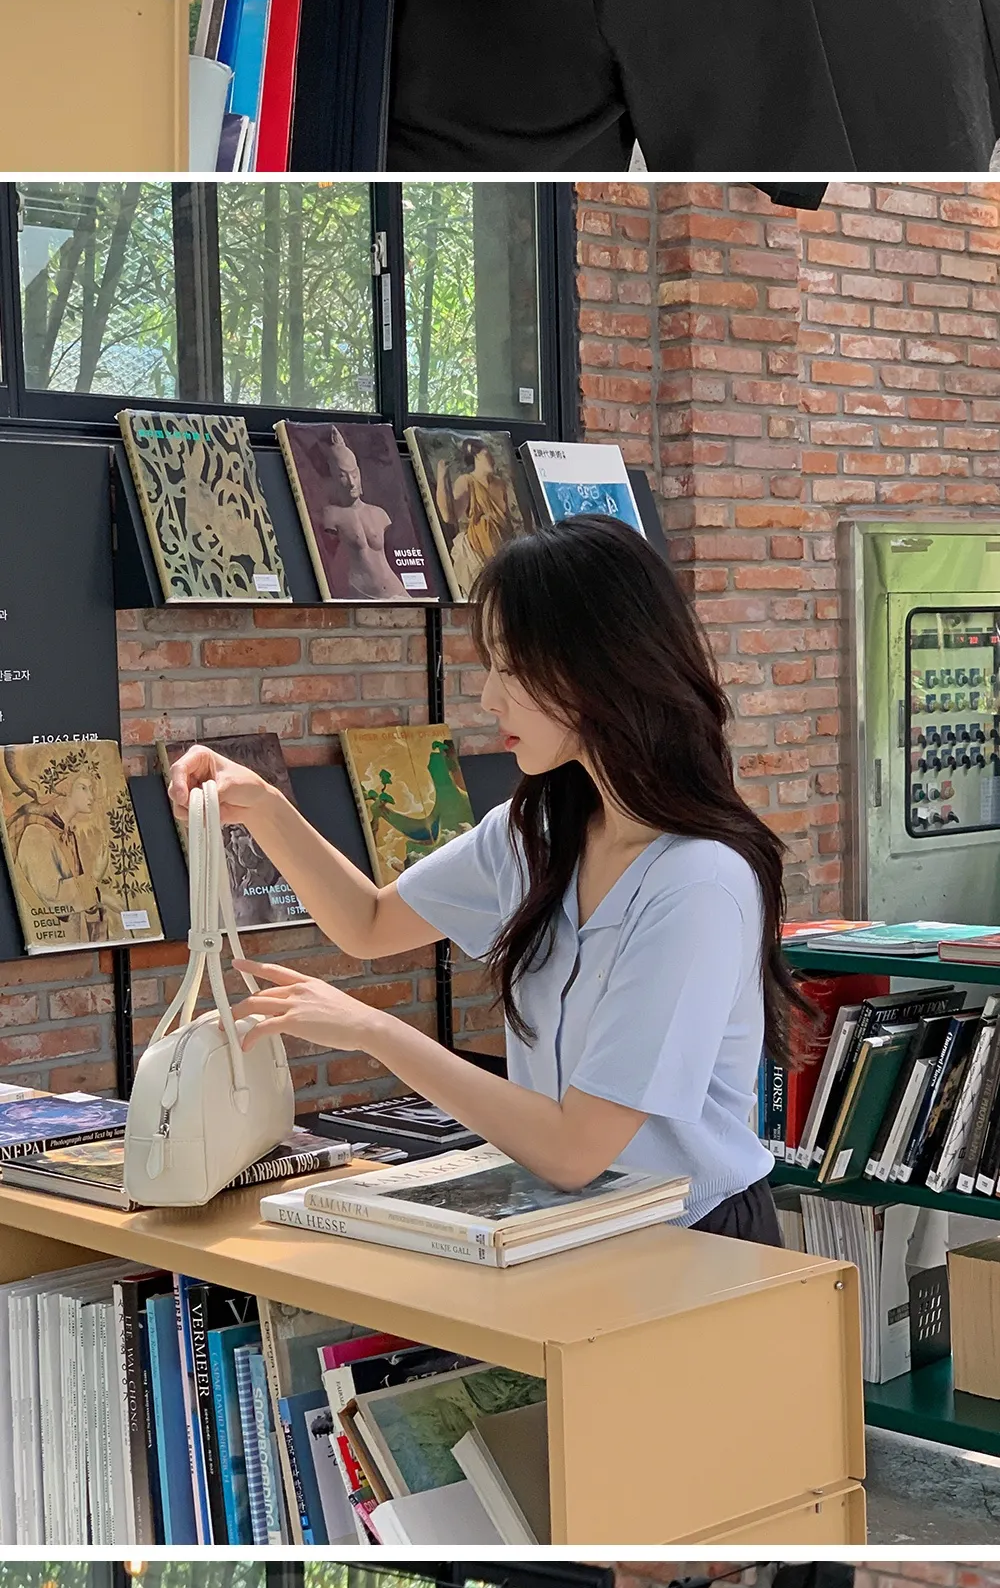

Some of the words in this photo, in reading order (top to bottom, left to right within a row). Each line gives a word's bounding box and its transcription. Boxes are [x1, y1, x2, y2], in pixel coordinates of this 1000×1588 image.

[394, 547, 423, 557] MUSÉE
[395, 558, 425, 566] GUIMET
[31, 905, 75, 916] GALLERIA
[33, 918, 60, 928] DEGLI
[36, 930, 66, 940] UFFIZI
[875, 1008, 900, 1023] THE
[773, 1066, 784, 1112] HORSE
[331, 1094, 417, 1116] CASABELLA
[50, 1135, 82, 1147] Photograph
[82, 1133, 94, 1141] and
[94, 1131, 105, 1140] Text
[106, 1129, 113, 1138] by
[296, 1152, 320, 1173] 1995
[309, 1194, 370, 1218] KAMAKURA
[278, 1208, 302, 1225] EVA
[306, 1216, 347, 1234] HESSE
[431, 1241, 451, 1253] KUKJE
[452, 1244, 471, 1256] GALL
[225, 1296, 250, 1325] V
[191, 1303, 210, 1398] VERMEER
[128, 1378, 139, 1433] CHONG
